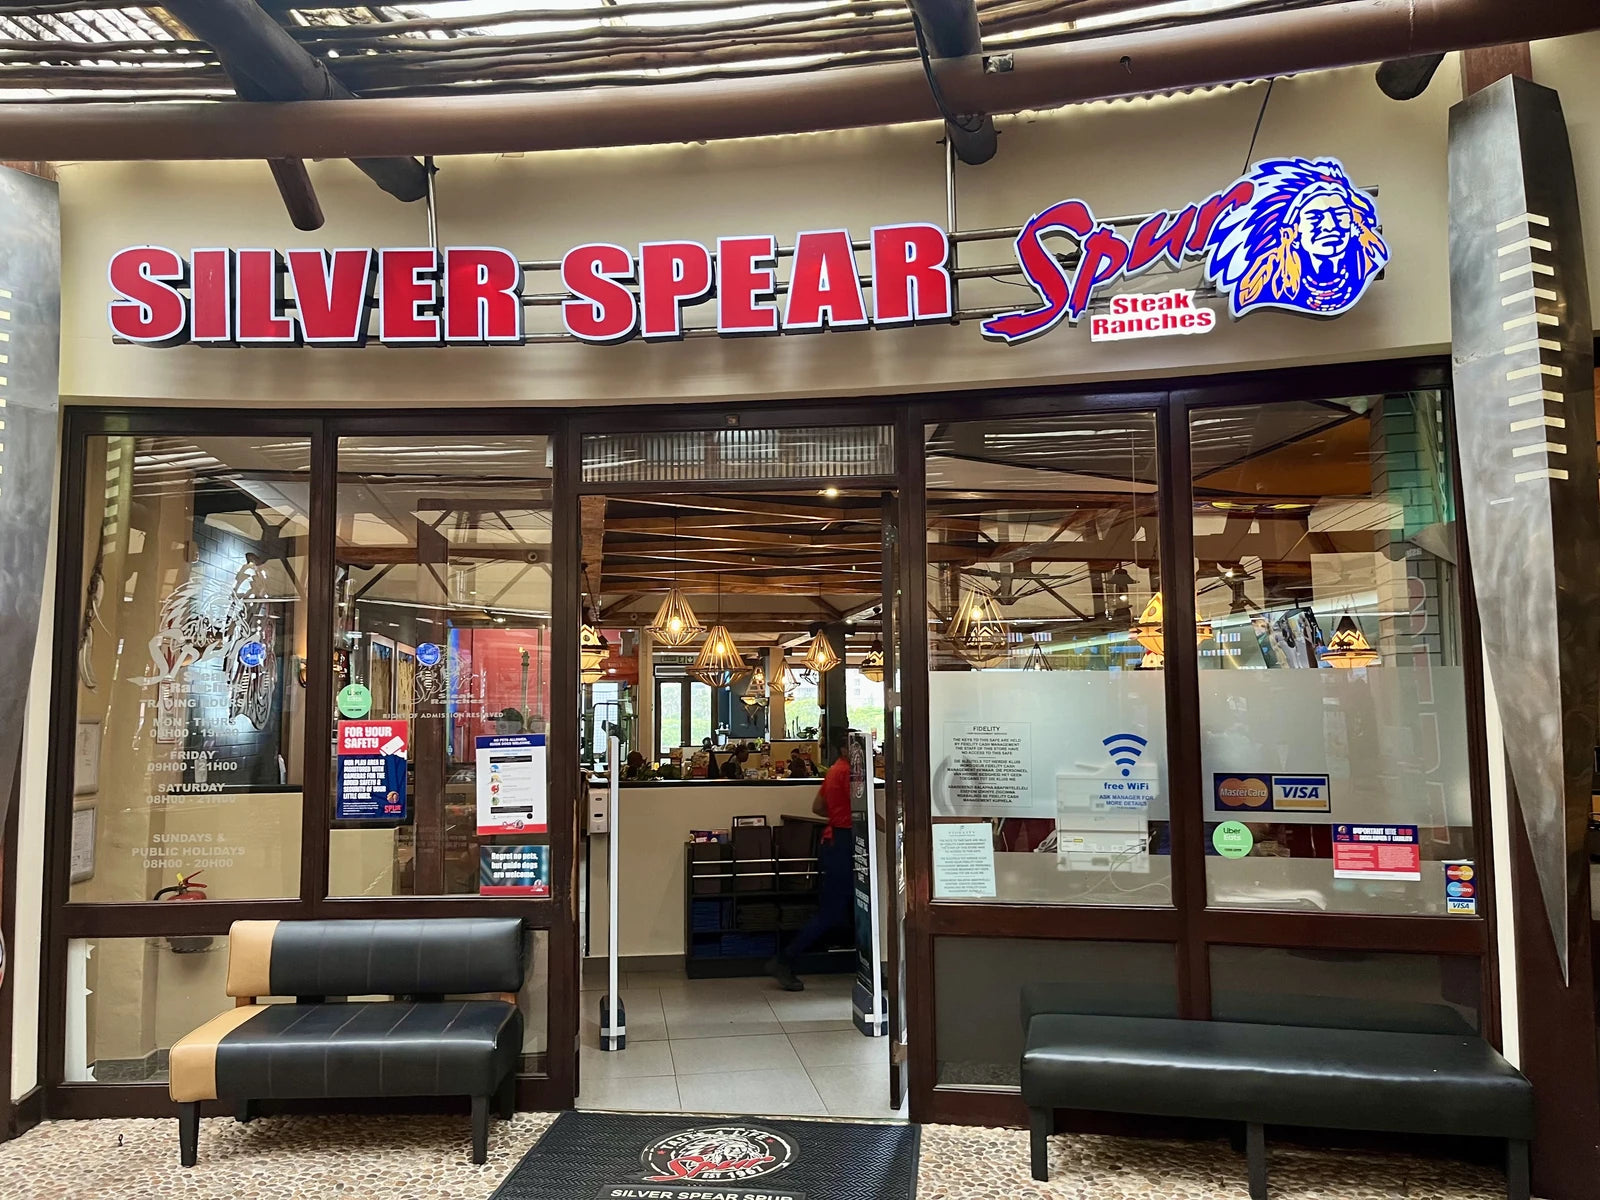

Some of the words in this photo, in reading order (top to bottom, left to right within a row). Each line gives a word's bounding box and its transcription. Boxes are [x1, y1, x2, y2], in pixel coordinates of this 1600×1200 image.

[980, 183, 1254, 341] Spur
[107, 245, 524, 344] SILVER
[561, 223, 953, 341] SPEAR
[1113, 292, 1189, 312] Steak
[1093, 311, 1211, 335] Ranches
[153, 718, 182, 727] MON
[150, 728, 189, 737] 0H00
[344, 726, 364, 737] FOR
[365, 726, 392, 737] YOUR
[344, 738, 379, 749] SAFETY
[170, 751, 216, 760] FRIDAY
[147, 762, 187, 771] 09H00
[199, 762, 238, 771] 21H00
[158, 783, 225, 792] SATURDAY
[1104, 782, 1124, 790] free
[1126, 782, 1149, 790] WiFi
[1220, 788, 1267, 797] MasterCard
[1281, 786, 1320, 799] VISA
[153, 834, 212, 843] SUNDAYS
[132, 847, 178, 857] PUBLIC
[183, 847, 246, 856] HOLIDAYS
[143, 859, 182, 868] 08H00
[194, 859, 233, 868] 20H00
[503, 862, 521, 870] guide
[642, 1155, 776, 1181] Spur
[727, 1166, 764, 1179] 1967
[610, 1189, 674, 1199] SILVER
[677, 1191, 739, 1200] SPEAR
